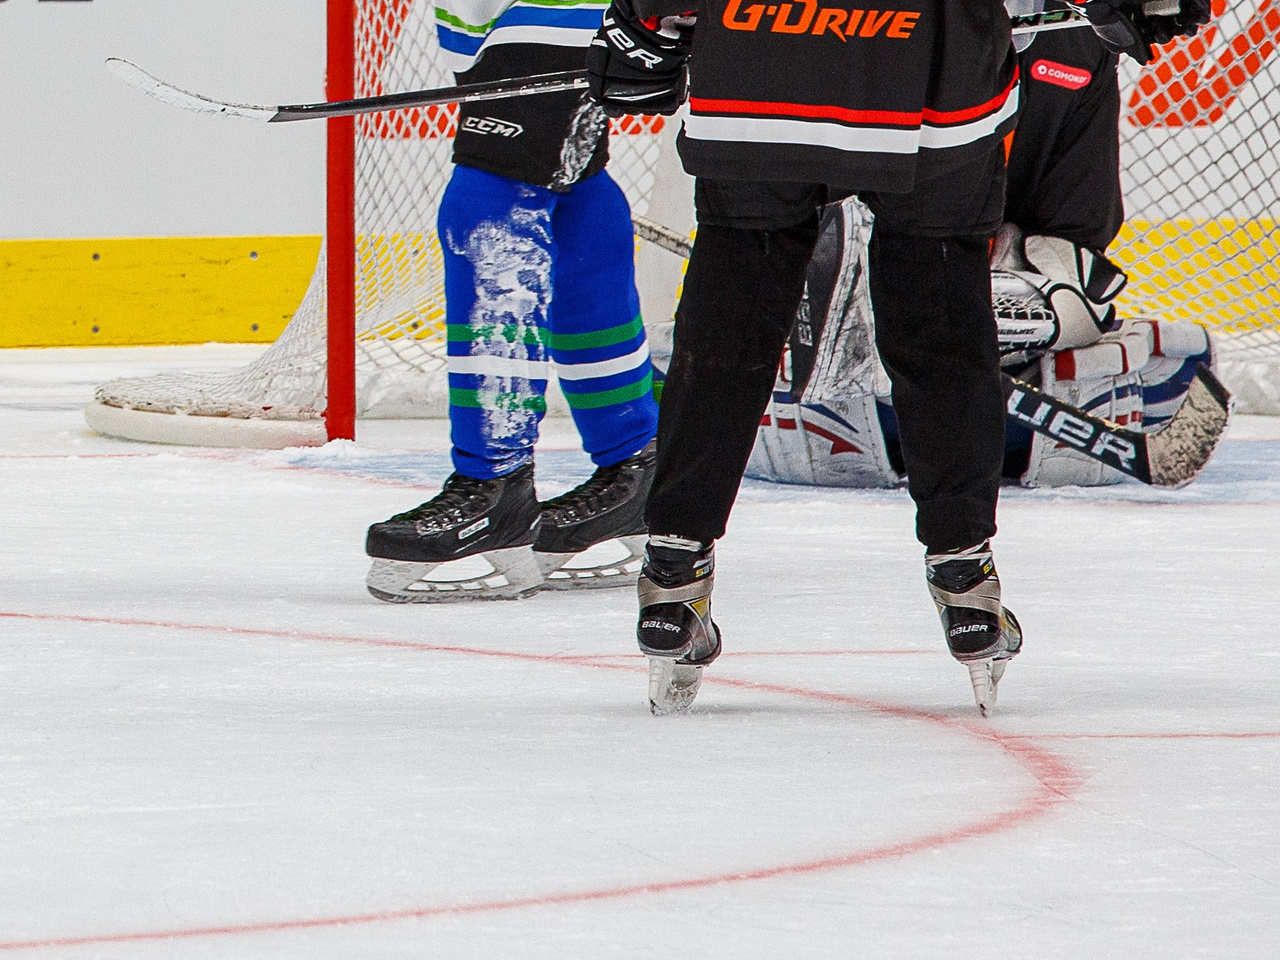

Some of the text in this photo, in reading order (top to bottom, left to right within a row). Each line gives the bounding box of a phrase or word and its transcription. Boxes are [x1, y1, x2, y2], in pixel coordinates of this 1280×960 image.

[465, 118, 516, 137] CCM
[641, 621, 681, 634] BAUER
[949, 625, 989, 637] BAUER
